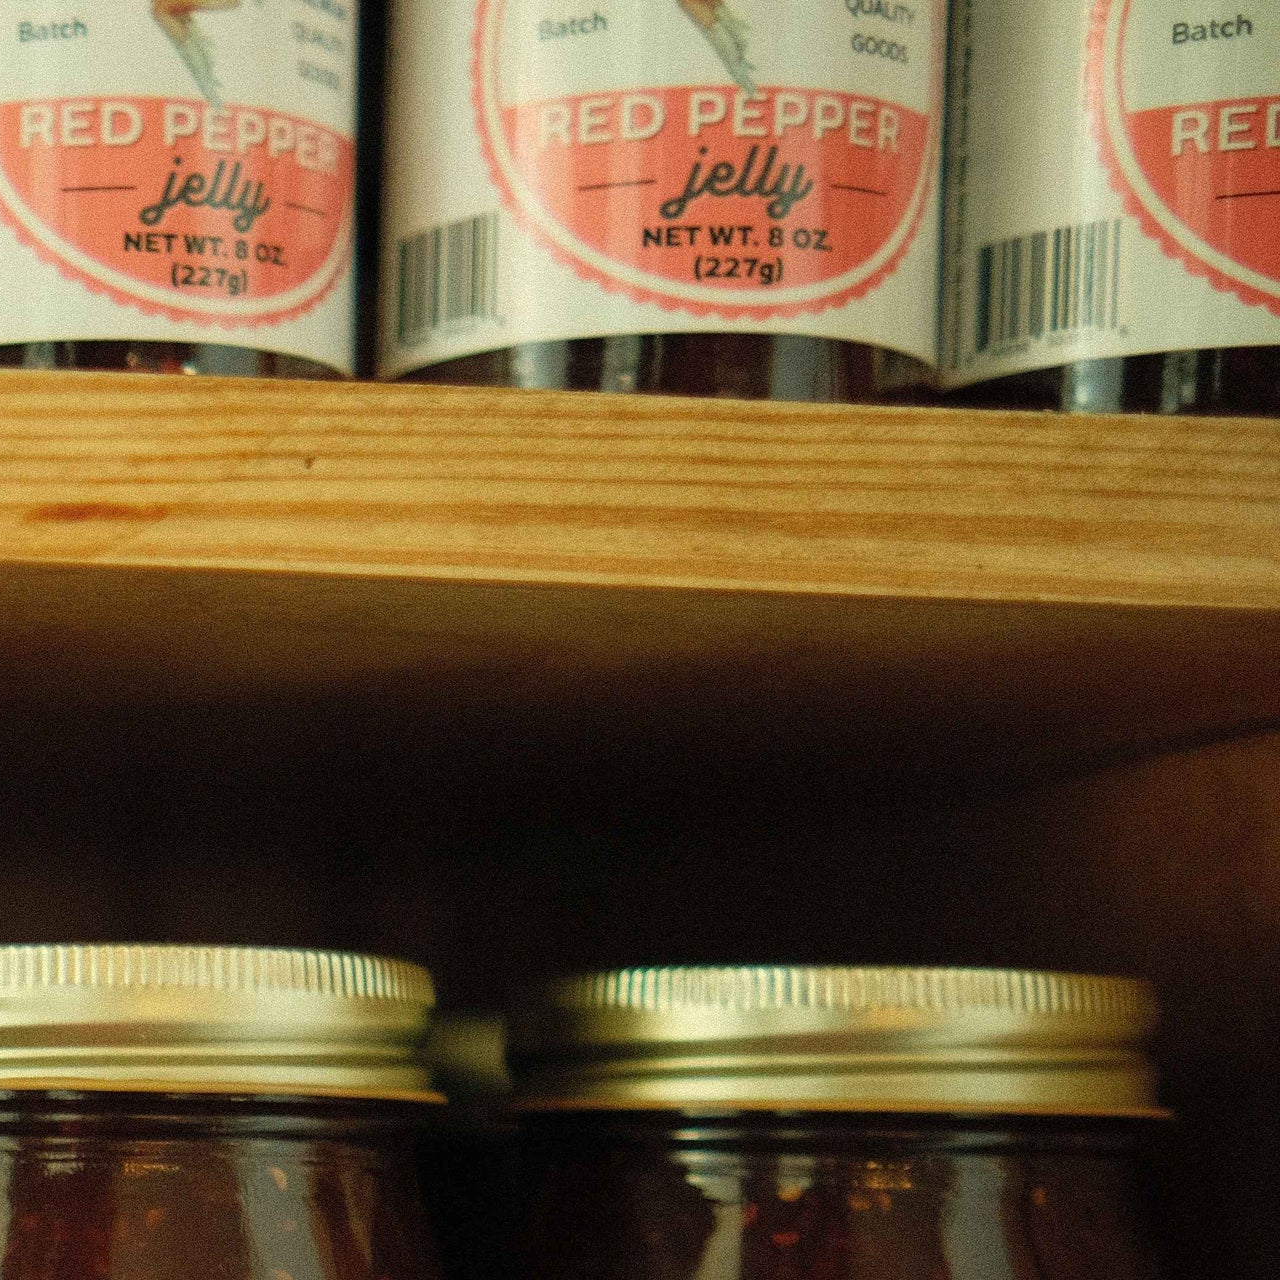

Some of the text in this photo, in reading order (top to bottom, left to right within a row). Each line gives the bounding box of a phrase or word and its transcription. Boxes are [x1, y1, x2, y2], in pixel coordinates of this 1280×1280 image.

[539, 11, 608, 41] Batch
[1171, 14, 1254, 45] Batch
[851, 33, 909, 63] GOODS
[542, 91, 901, 153] RED PEPPER
[20, 103, 340, 174] RED PEPPER
[140, 158, 271, 233] jelly
[661, 145, 813, 220] jelly
[124, 232, 177, 256] NET
[643, 225, 698, 249] NET
[710, 225, 760, 249] WT.
[768, 227, 784, 249] 8
[693, 253, 784, 285] (227g)
